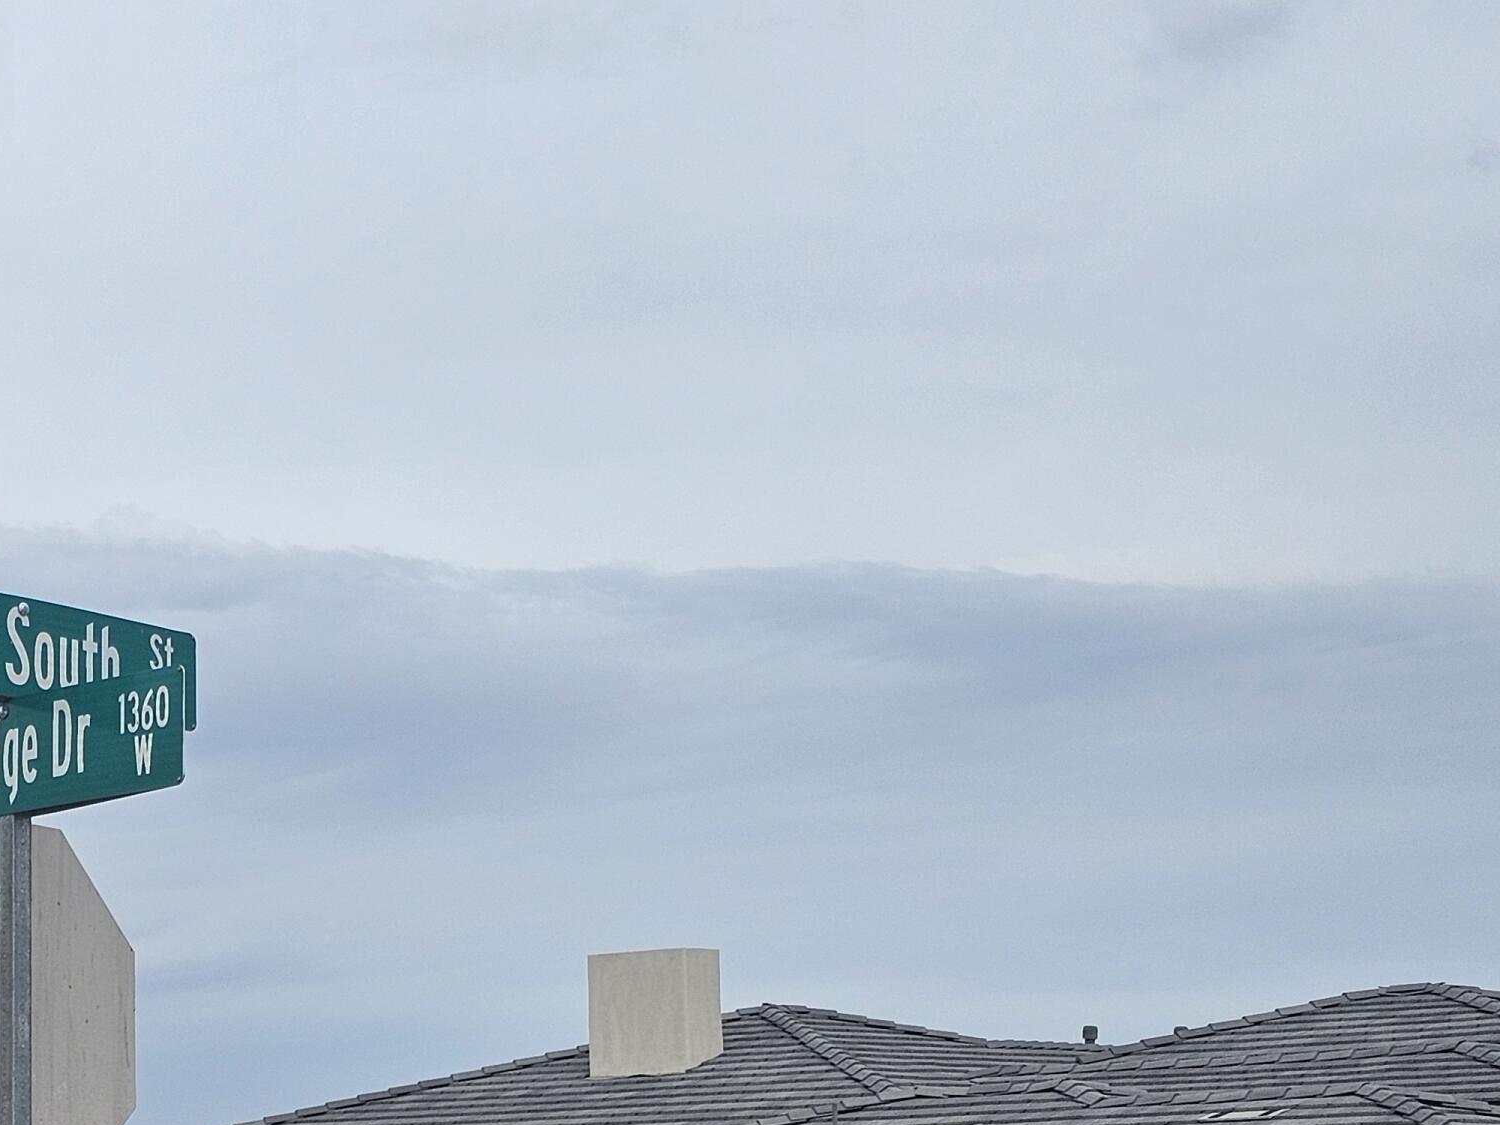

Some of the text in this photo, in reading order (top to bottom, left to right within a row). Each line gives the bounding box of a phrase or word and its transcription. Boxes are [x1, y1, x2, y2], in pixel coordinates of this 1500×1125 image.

[5, 605, 120, 690] South
[149, 633, 174, 670] St
[52, 699, 91, 778] Dr
[118, 685, 170, 735] 1360
[134, 733, 154, 776] W
